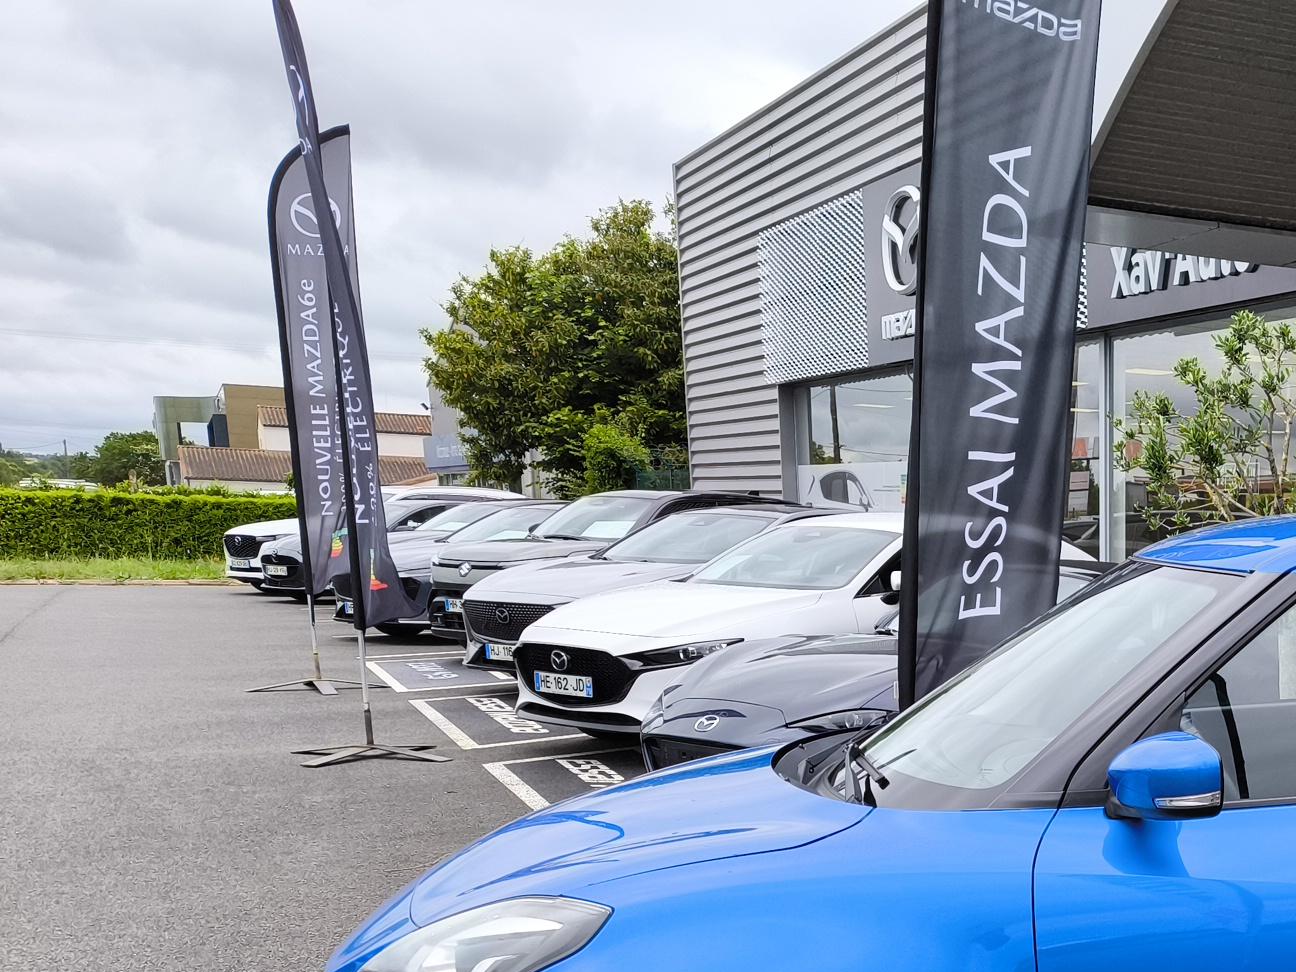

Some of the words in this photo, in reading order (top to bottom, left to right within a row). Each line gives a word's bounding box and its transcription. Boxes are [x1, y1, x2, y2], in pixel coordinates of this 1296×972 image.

[288, 243, 350, 256] MAZA
[970, 146, 1032, 424] MAZDA
[297, 278, 327, 397] MAZDA6e
[881, 309, 916, 340] maz
[310, 403, 334, 516] NOUVELLE
[958, 451, 1016, 620] ESSAI
